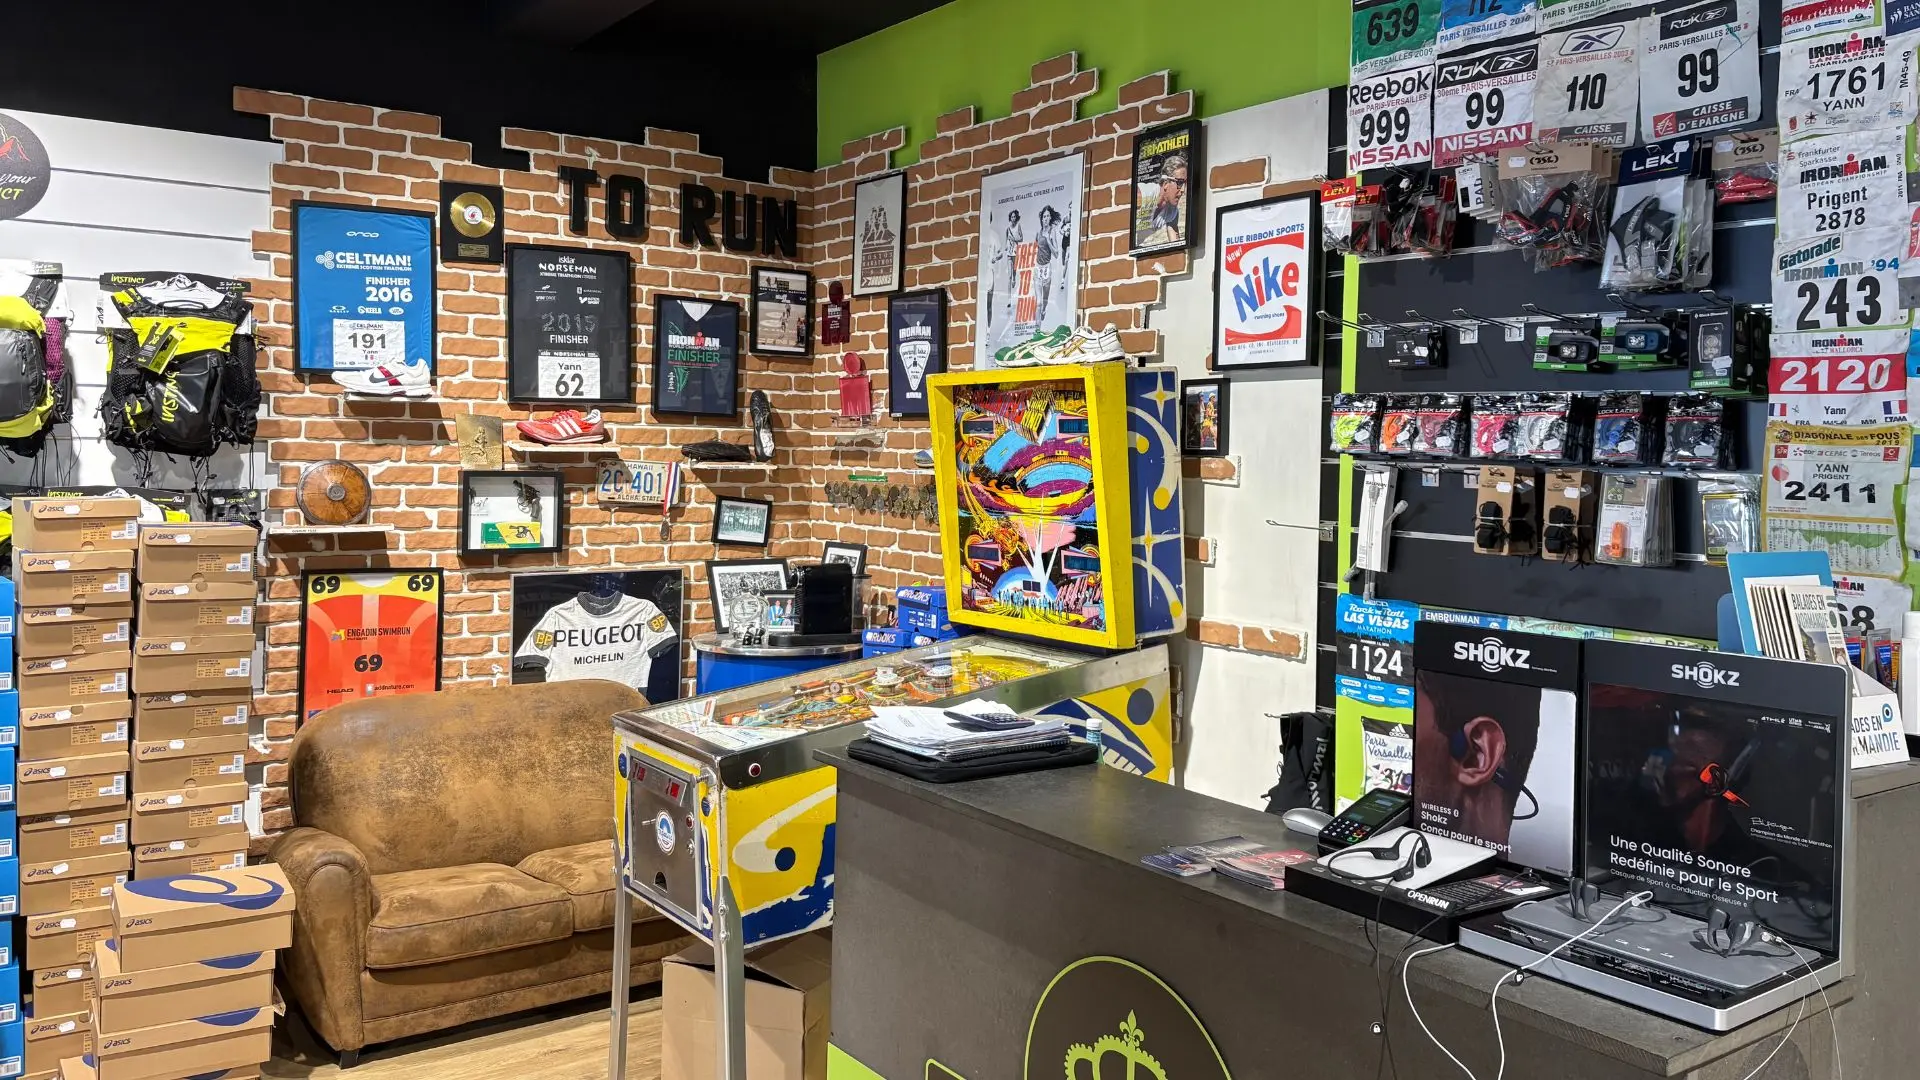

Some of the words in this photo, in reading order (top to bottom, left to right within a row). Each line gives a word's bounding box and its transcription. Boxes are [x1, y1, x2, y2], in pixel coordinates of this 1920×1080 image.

[1367, 2, 1420, 46] 639
[1542, 8, 1566, 20] PARIS
[1439, 31, 1460, 43] PARIS
[1462, 20, 1507, 37] VERSAILLES
[1659, 31, 1723, 52] PARIS-VERSAILLES
[1808, 33, 1886, 60] IRONMAN
[1809, 46, 1886, 64] LANZAROTE
[1354, 64, 1368, 75] PARIS
[1370, 52, 1413, 68] VERSAILLES
[1414, 48, 1433, 58] 2009
[1900, 50, 1912, 89] M45-49
[1461, 71, 1536, 94] PARIS-VERSAILLES
[1678, 48, 1718, 98] 99
[1806, 62, 1887, 100] 1761
[1350, 72, 1432, 106] Reebok
[1566, 73, 1607, 112] 110
[1784, 88, 1800, 97] FRA
[1465, 87, 1504, 130] 99
[1692, 100, 1732, 117] CAISSE
[1823, 96, 1865, 112] YANN
[1358, 106, 1410, 148] 999
[1574, 124, 1611, 134] CAISSE
[1678, 110, 1746, 132] D'EPARGNE
[1443, 124, 1526, 152] NISSAN
[1350, 140, 1430, 167] NISSAN
[1632, 151, 1682, 172] LEKI
[1798, 146, 1840, 158] Frankfurter
[1800, 156, 1837, 168] Sparkasse
[1800, 154, 1887, 184] IRONMAN
[0, 175, 36, 185] your
[1800, 180, 1834, 190] EUROPEAN
[1838, 170, 1887, 184] CHAMPIONSHIP
[1324, 186, 1351, 198] LEKI
[1474, 178, 1484, 206] PAD
[1807, 186, 1868, 210] Prigent
[558, 164, 648, 239] TO
[679, 182, 798, 258] RUN
[1816, 206, 1866, 232] 2878
[1226, 234, 1244, 245] BLUE
[1246, 228, 1274, 242] RIBBON
[1276, 222, 1305, 238] SPORTS
[336, 252, 412, 266] CELTMAN!
[558, 256, 576, 264] isklar
[1014, 240, 1038, 271] FREE
[1226, 246, 1243, 263] New!
[1779, 232, 1841, 272] Gatorade
[538, 262, 597, 274] NORSEMAN
[1784, 258, 1864, 282] IRONMAN
[366, 276, 410, 286] FINISHER
[1018, 270, 1032, 296] TO
[1232, 256, 1300, 324] Nike
[366, 286, 414, 303] 2016
[1797, 275, 1882, 331] 243
[1015, 296, 1038, 323] RUN
[550, 334, 589, 344] FINISHER
[668, 332, 720, 348] IRONMAN
[899, 321, 932, 339] IRONMAN
[348, 332, 386, 349] 191
[1812, 334, 1862, 348] IRONMAN
[558, 362, 582, 370] Yann
[668, 350, 720, 363] FINISHER
[556, 373, 584, 396] 62
[1780, 358, 1891, 392] 2120
[1824, 406, 1846, 415] Yann
[1022, 410, 1043, 432] KIND
[1794, 431, 1854, 440] DIAGONALE
[1870, 432, 1900, 440] FOUS
[1816, 464, 1849, 473] YANN
[602, 469, 623, 492] 2C
[631, 470, 662, 495] 401
[1784, 480, 1876, 504] 2411
[312, 576, 340, 594] 69
[408, 574, 435, 592] 69
[1791, 593, 1818, 610] BALADES
[1820, 594, 1826, 611] EN
[652, 616, 666, 630] BP
[1344, 612, 1364, 624] LAS
[1368, 614, 1410, 630] VEGAS
[1426, 611, 1480, 626] EMBRUNMAN
[347, 628, 377, 638] ENGADIN
[378, 626, 410, 636] SWIMRUN
[536, 632, 552, 646] BP
[553, 622, 644, 648] PEUGEOT
[1358, 625, 1392, 634] MARATHON
[354, 654, 382, 672] 69
[574, 652, 624, 664] MICHELIN
[1349, 643, 1404, 676] 1124
[1454, 641, 1530, 669] SHOKZ
[1672, 664, 1740, 687] SHOKZ
[1872, 716, 1883, 730] EN
[1364, 733, 1388, 748] Paris
[1421, 811, 1448, 824] Shokz
[1422, 802, 1452, 814] WIRELESS
[1420, 823, 1450, 838] Conçu
[1450, 831, 1473, 843] pour
[1474, 836, 1483, 846] le
[1485, 840, 1512, 854] sport
[1610, 834, 1638, 853] Une
[1641, 842, 1692, 866] Qualité
[1697, 855, 1751, 878] Sonore
[1610, 851, 1674, 878] Redéfinie
[1678, 870, 1714, 889] pour
[1718, 876, 1732, 892] le
[1736, 882, 1779, 904] Sport
[1610, 868, 1636, 881] Casque
[1646, 876, 1664, 888] Sport
[1672, 882, 1710, 898] Conduction
[1712, 893, 1742, 907] Osseuse
[1408, 890, 1450, 910] OPENRUN
[134, 918, 153, 926] asics
[114, 978, 132, 986] asics
[112, 1038, 131, 1046] asics
